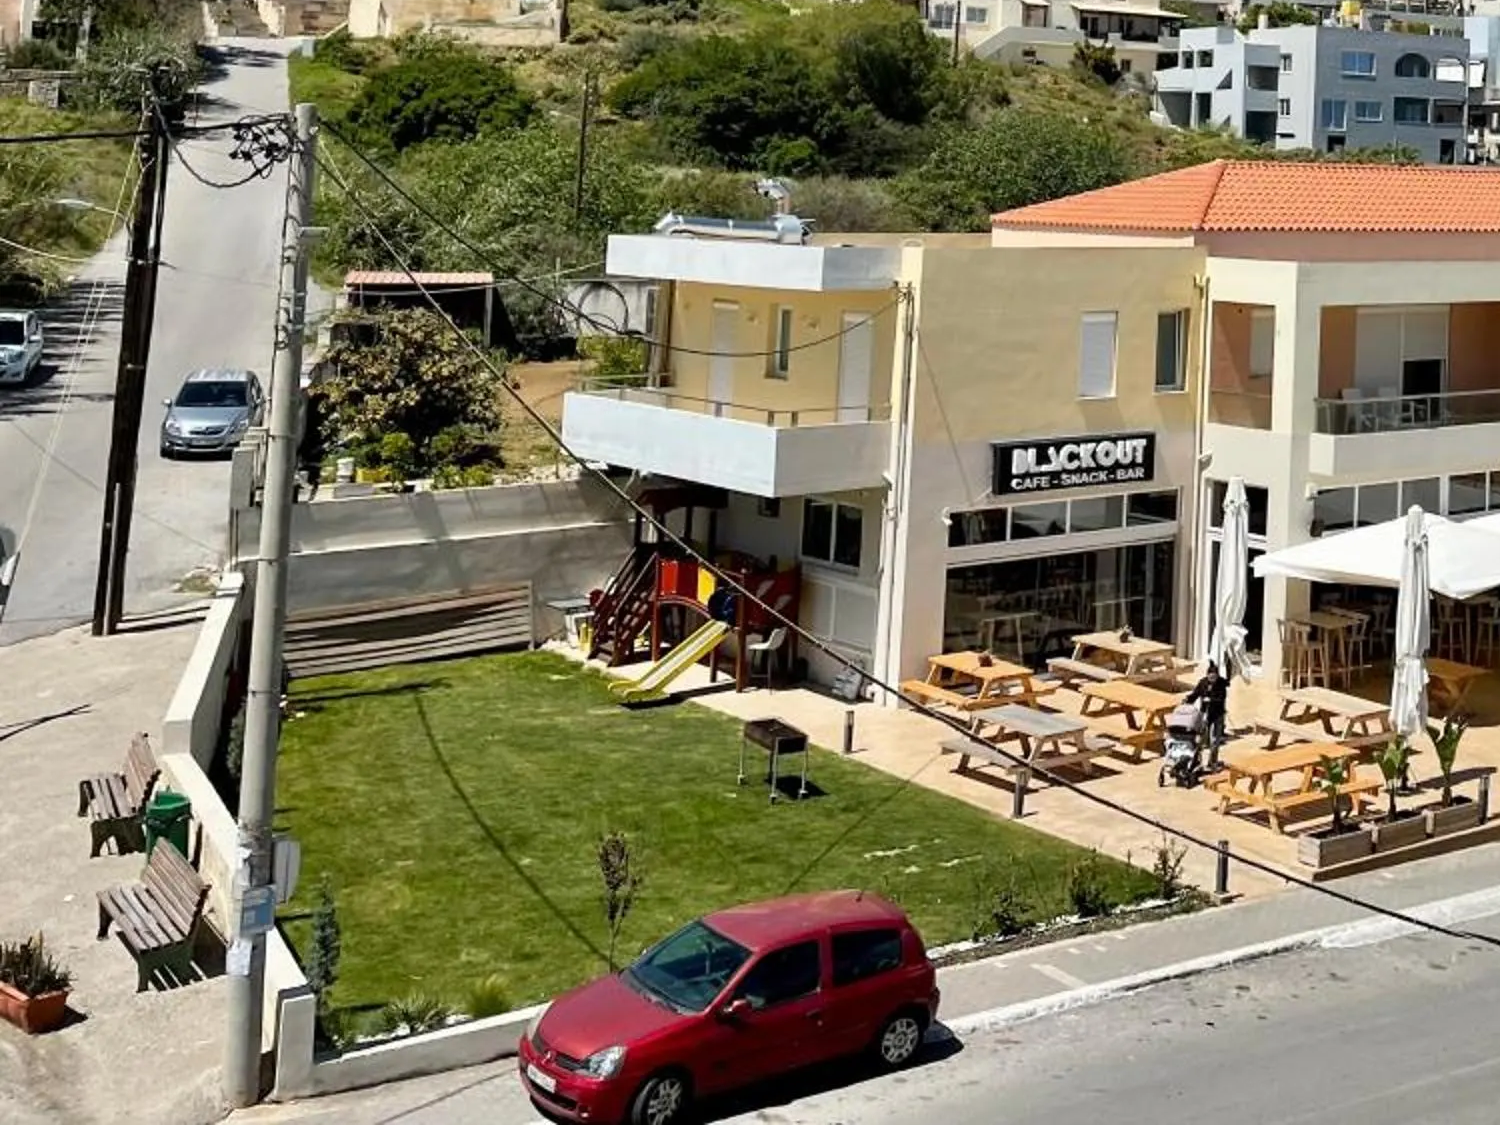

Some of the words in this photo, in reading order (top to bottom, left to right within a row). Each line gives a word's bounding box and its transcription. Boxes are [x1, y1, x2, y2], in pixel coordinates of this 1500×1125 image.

[1011, 438, 1147, 475] BLACKOUT
[1010, 476, 1051, 490] CAFE
[1060, 470, 1109, 486] SNACK
[1116, 467, 1145, 479] BAR
